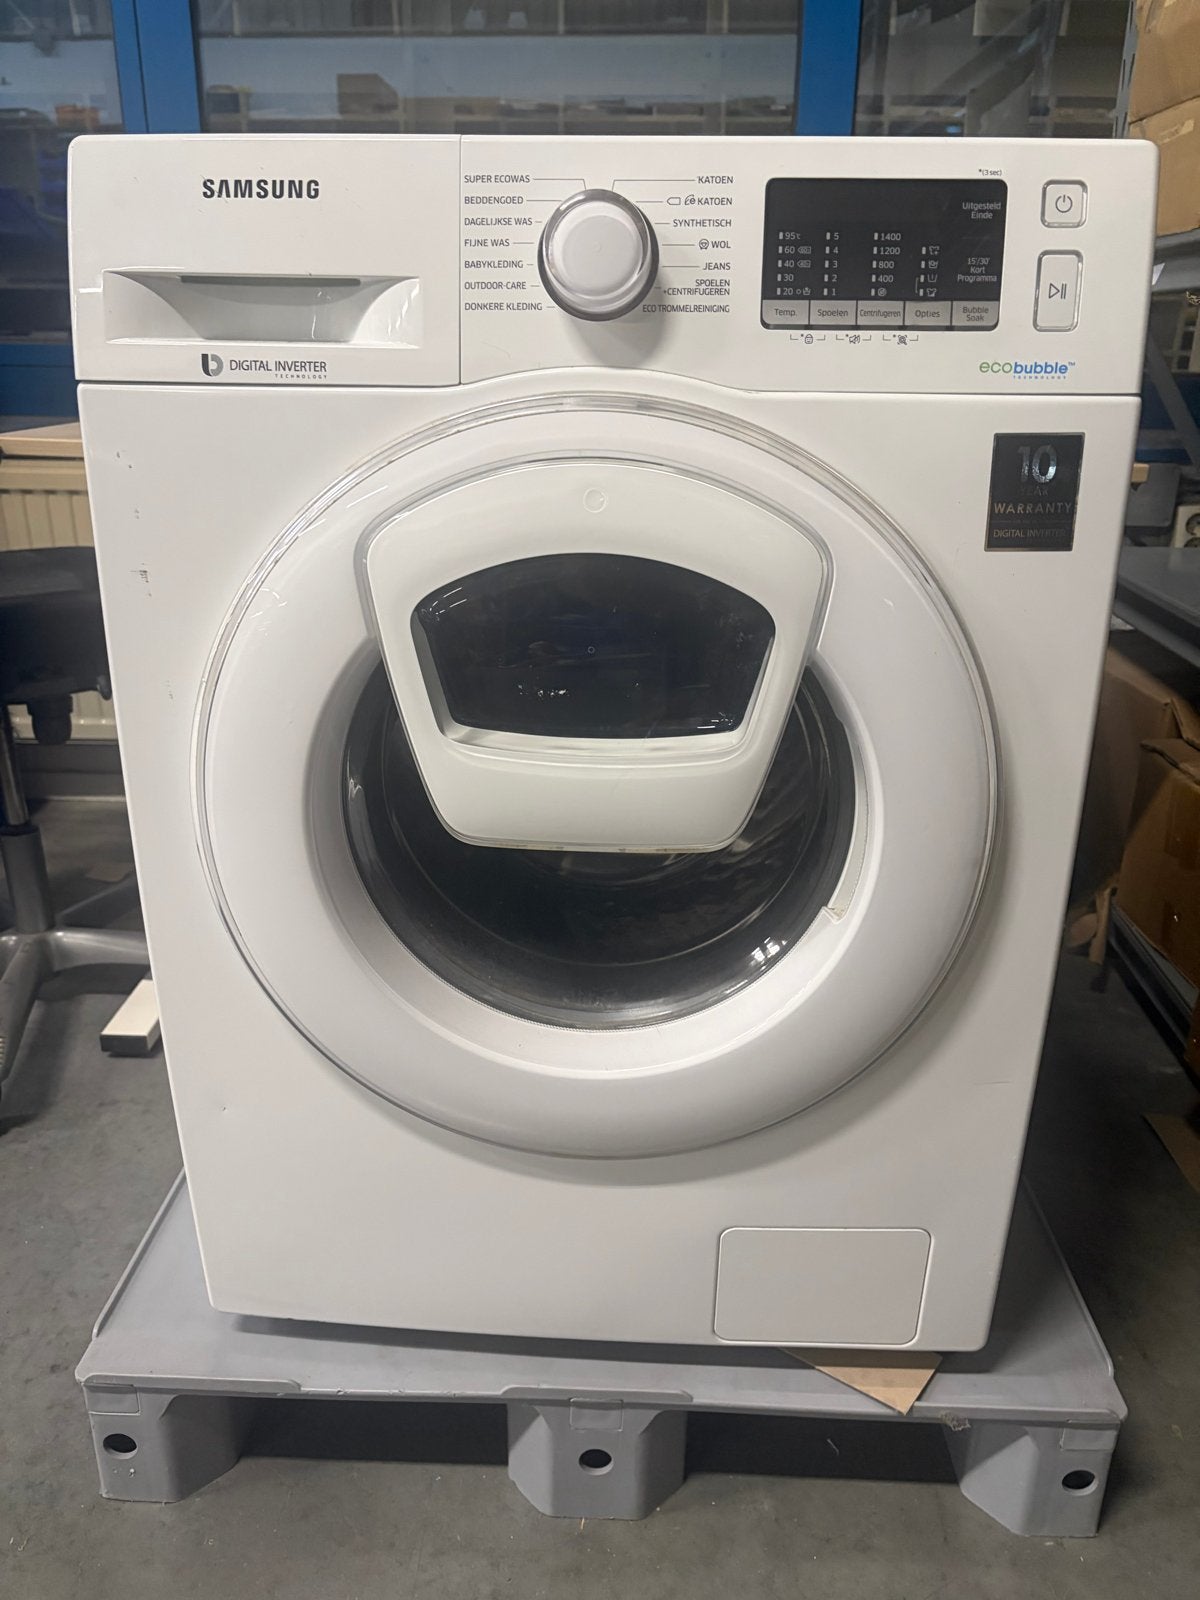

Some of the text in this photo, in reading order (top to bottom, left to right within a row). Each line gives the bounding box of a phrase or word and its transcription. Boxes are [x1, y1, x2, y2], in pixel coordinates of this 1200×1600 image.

[464, 175, 530, 183] SUPER ECOWAS
[698, 176, 734, 184] KATOEN
[202, 179, 319, 199] SAMSUNG
[464, 196, 524, 204] BEDDENGOED
[698, 197, 732, 206] KATOEN
[962, 202, 1001, 211] Uitgesteld
[971, 211, 993, 219] Einde
[464, 217, 533, 226] DAGELIJKSE WAS
[673, 219, 732, 227] SYNTHETISCH
[834, 232, 839, 240] 5
[464, 239, 510, 247] FIJNE WAS
[784, 246, 795, 254] 60
[833, 246, 839, 254] 4
[880, 247, 900, 255] 1200
[464, 260, 523, 268] BABYKLEDING
[703, 262, 731, 270] JEANS
[784, 260, 794, 268] 40
[879, 261, 894, 269] 800
[783, 274, 794, 282] 30
[832, 274, 838, 282] 2
[958, 274, 997, 283] Programma
[464, 281, 526, 290] OUTDOOR-CARE
[695, 279, 730, 287] SPOELEN
[783, 287, 794, 296] 20
[832, 288, 836, 296] 1
[464, 303, 542, 311] DONKERE KLEDING
[962, 306, 989, 314] Bubble
[817, 309, 848, 318] Spoelen
[860, 309, 901, 318] Centrifugeren
[915, 310, 940, 318] Opties
[966, 314, 984, 322] Soak
[230, 360, 327, 372] DIGITAL INVERTER
[1018, 444, 1057, 483] 10
[994, 502, 1072, 514] WARRANTY
[993, 529, 1025, 538] DIGITAL
